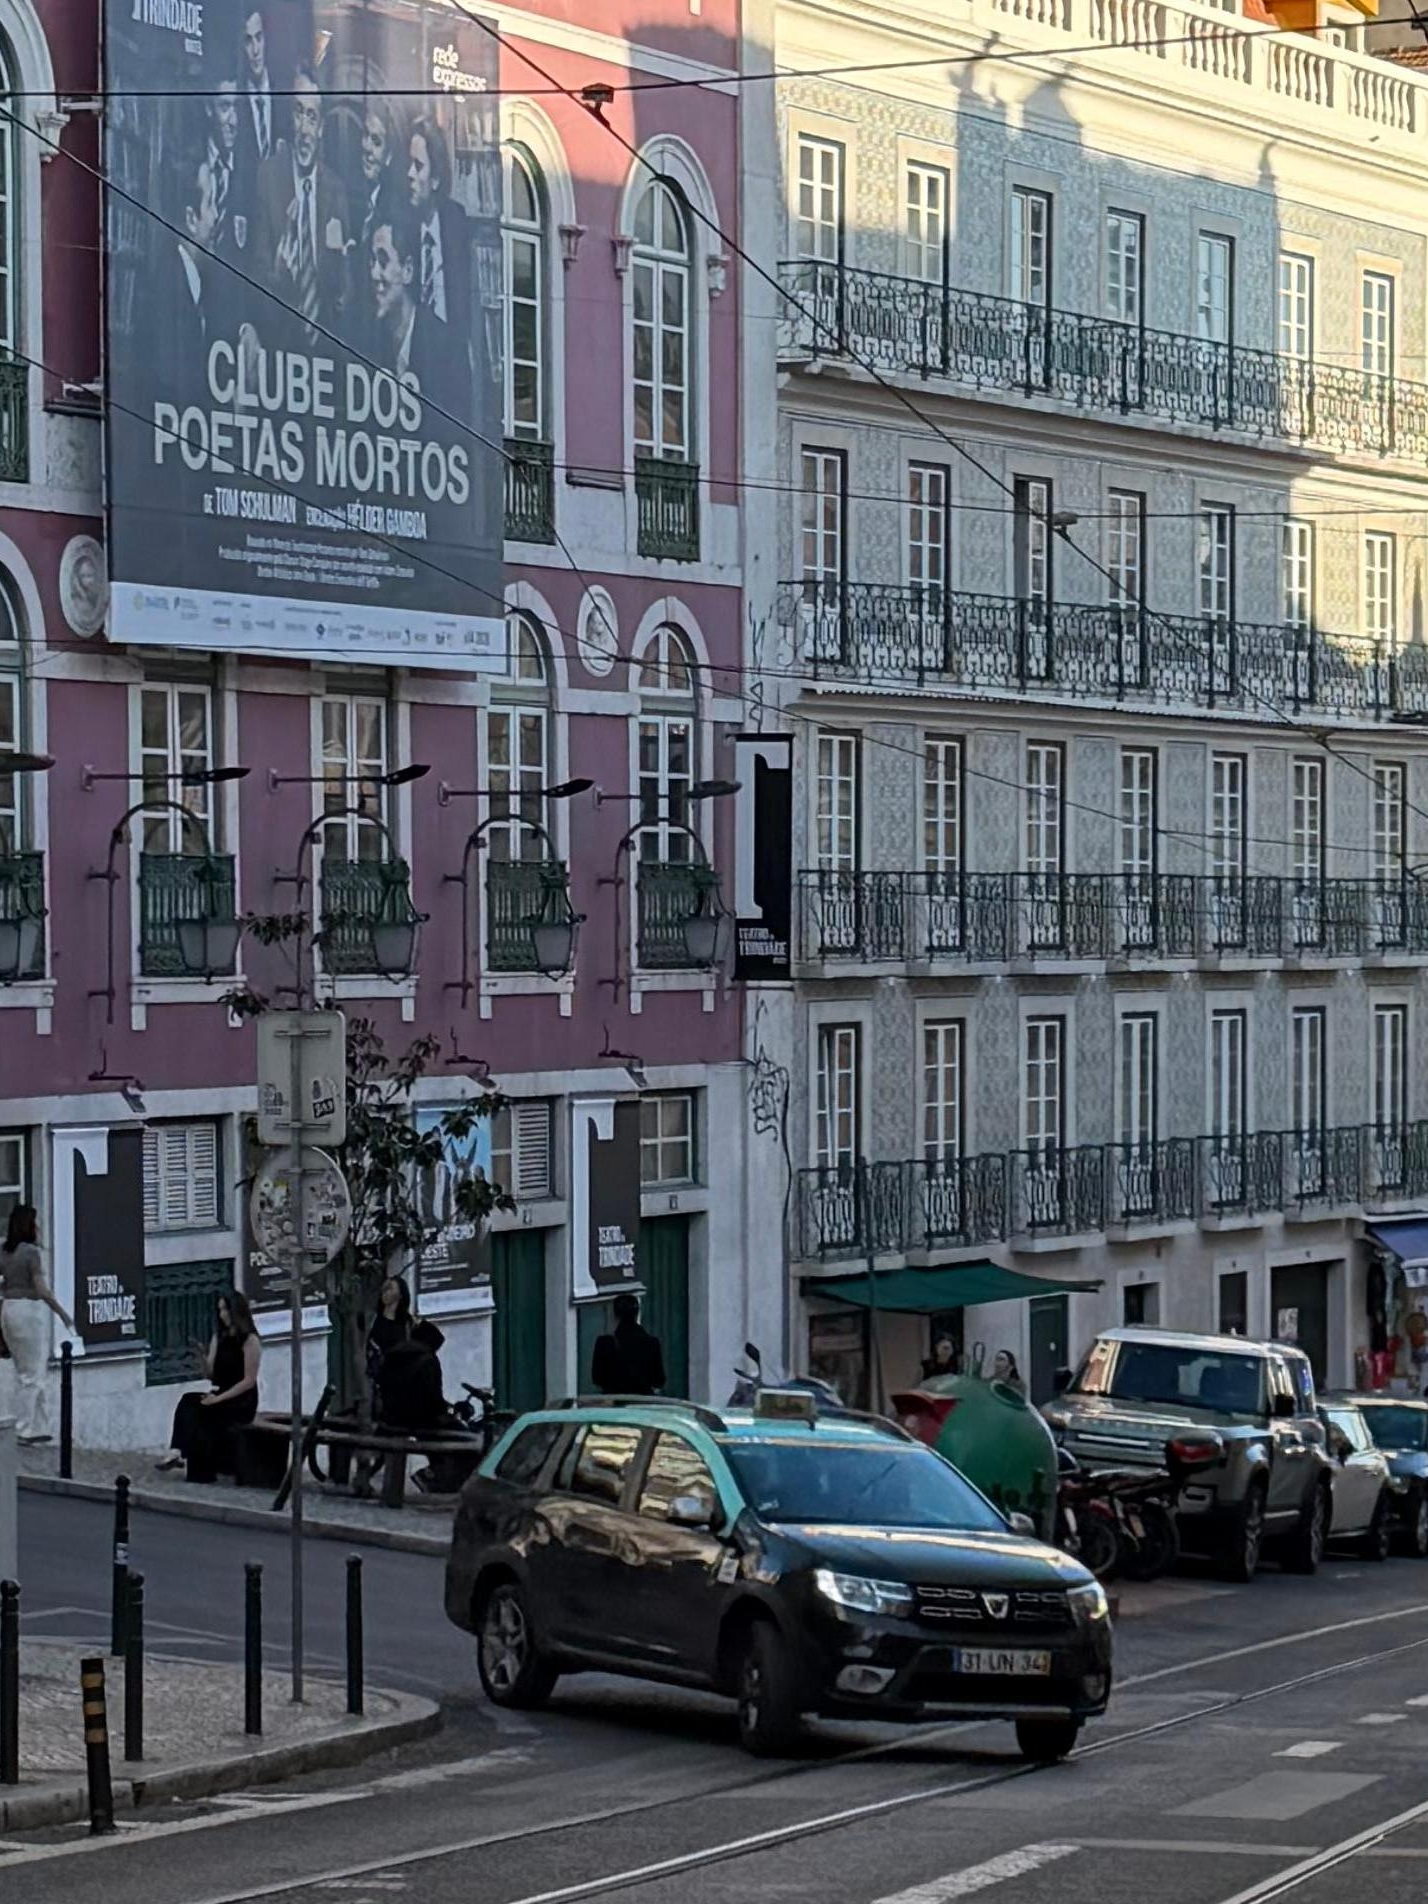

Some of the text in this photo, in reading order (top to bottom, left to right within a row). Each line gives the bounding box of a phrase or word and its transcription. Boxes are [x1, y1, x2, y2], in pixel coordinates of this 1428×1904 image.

[433, 44, 459, 69] rede
[208, 340, 422, 432] CLUBE DOS
[154, 401, 470, 505] POETAS MORTOS
[215, 487, 239, 517] TOM
[240, 490, 297, 524] SCHULMAN
[86, 1274, 119, 1296] TEATRO
[87, 1294, 137, 1325] TRINDADE
